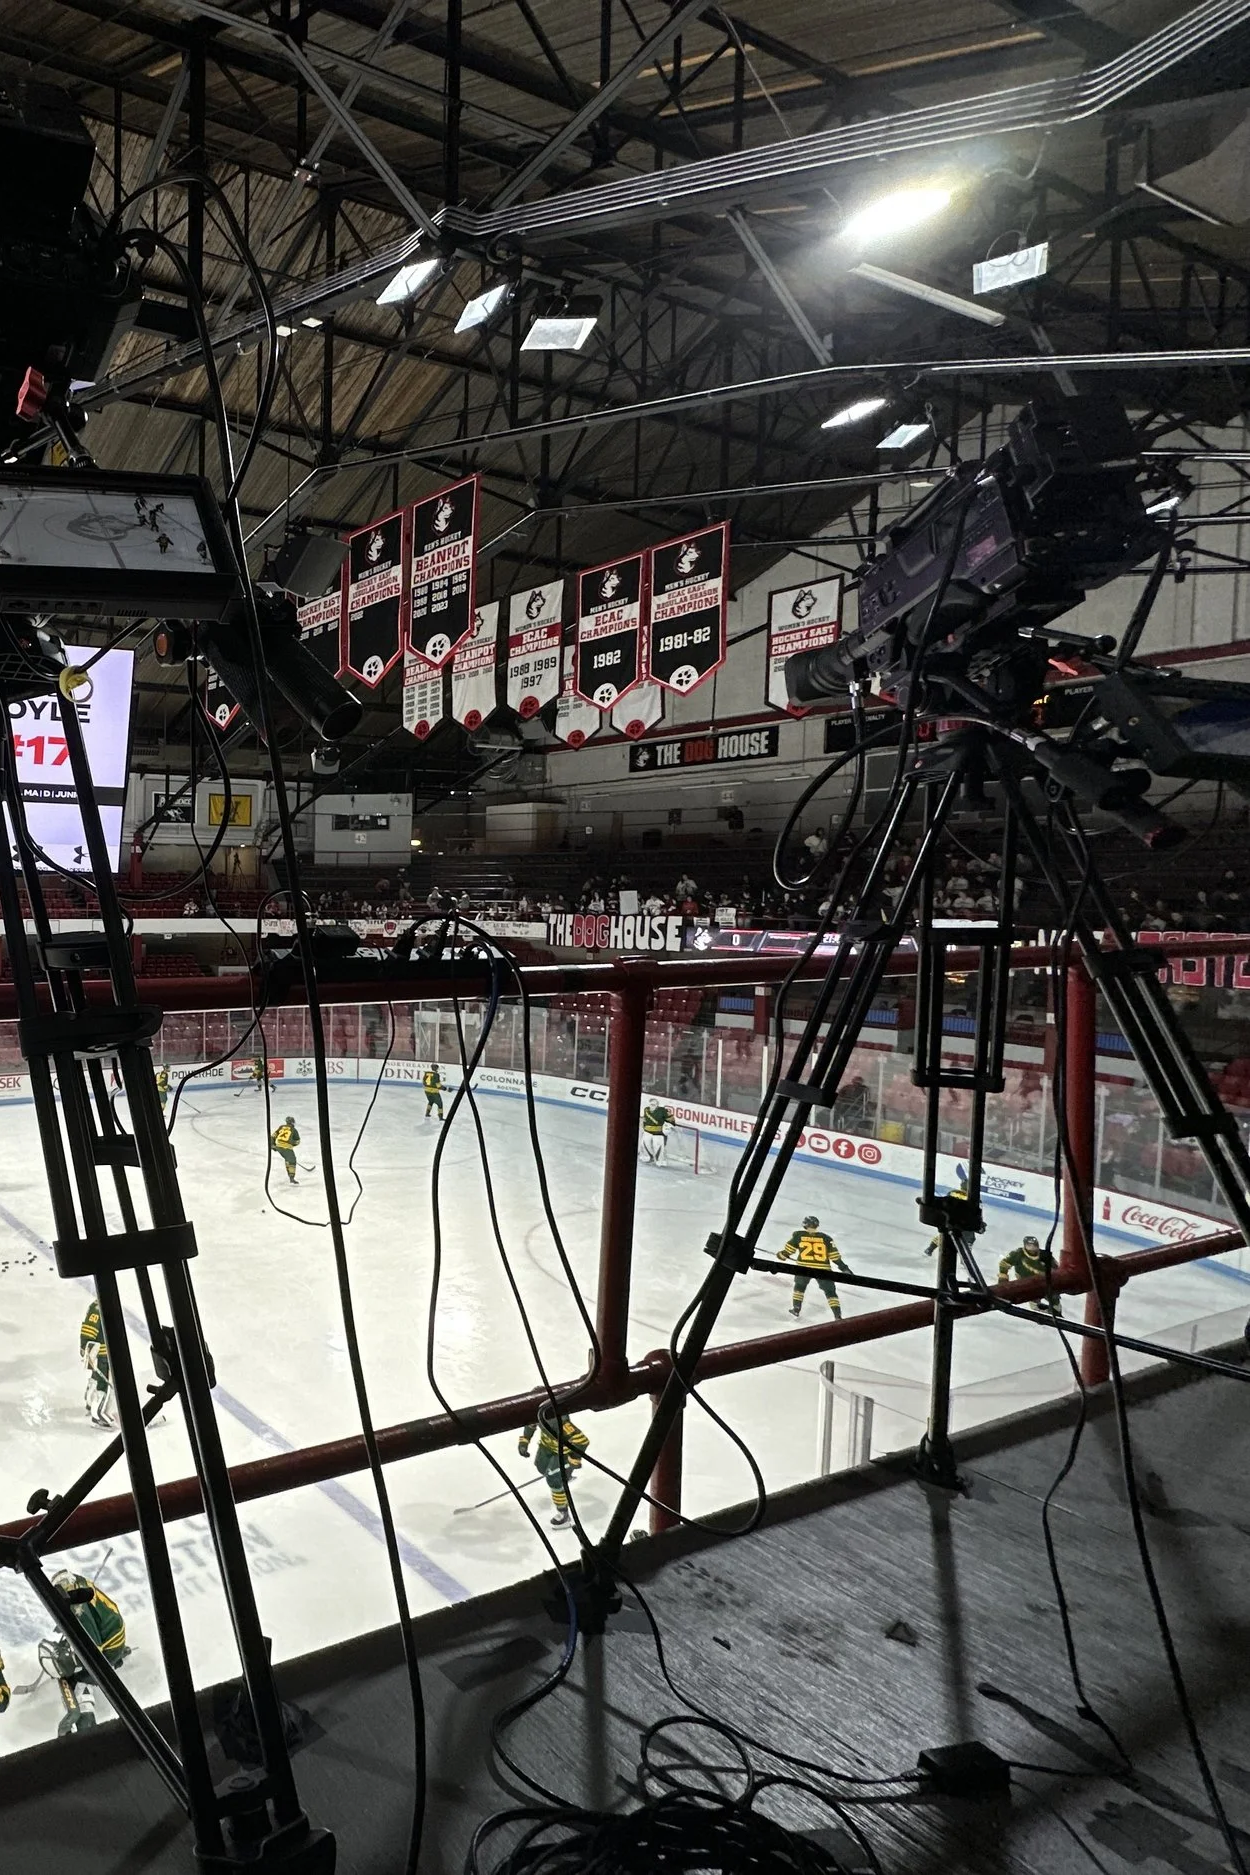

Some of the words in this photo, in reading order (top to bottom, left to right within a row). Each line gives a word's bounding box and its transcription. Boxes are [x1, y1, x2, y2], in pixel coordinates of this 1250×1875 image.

[415, 540, 469, 573] BEANPOT
[413, 555, 470, 585] CHAMPIONS
[350, 584, 401, 611] CHAMPIONS
[653, 593, 720, 621] CHAMPIONS
[594, 609, 624, 627] ECAC
[521, 628, 548, 644] ECAC
[580, 617, 638, 641] CHAMPIONS
[658, 625, 711, 653] 1981-82
[771, 630, 809, 646] HOCKEY
[809, 624, 835, 637] EAST
[454, 644, 496, 663] BEANPOT
[509, 636, 560, 657] CHAMPIONS
[771, 633, 835, 655] CHAMPIONS
[453, 655, 496, 672] CHAMPIONS
[533, 656, 557, 672] 1989
[592, 649, 622, 669] 1982
[520, 674, 543, 690] 1997
[1064, 685, 1094, 696] PLAYER
[6, 700, 92, 724] OYLE
[654, 743, 682, 767] THE
[682, 738, 716, 764] DOG
[716, 730, 770, 760] HOUSE
[23, 789, 40, 798] MA
[548, 913, 573, 947] THE
[572, 914, 610, 949] DOG
[609, 915, 684, 952] HOUSE
[384, 1067, 447, 1083] DINIG
[479, 1073, 538, 1089] COLONNAE
[570, 1086, 608, 1102] CC
[664, 1104, 781, 1141] @GONUATHLETS
[984, 1180, 1008, 1189] EAST
[986, 1175, 1026, 1188] HOCKEY
[1121, 1205, 1202, 1241] Coca-Cola
[798, 1241, 827, 1262] 29
